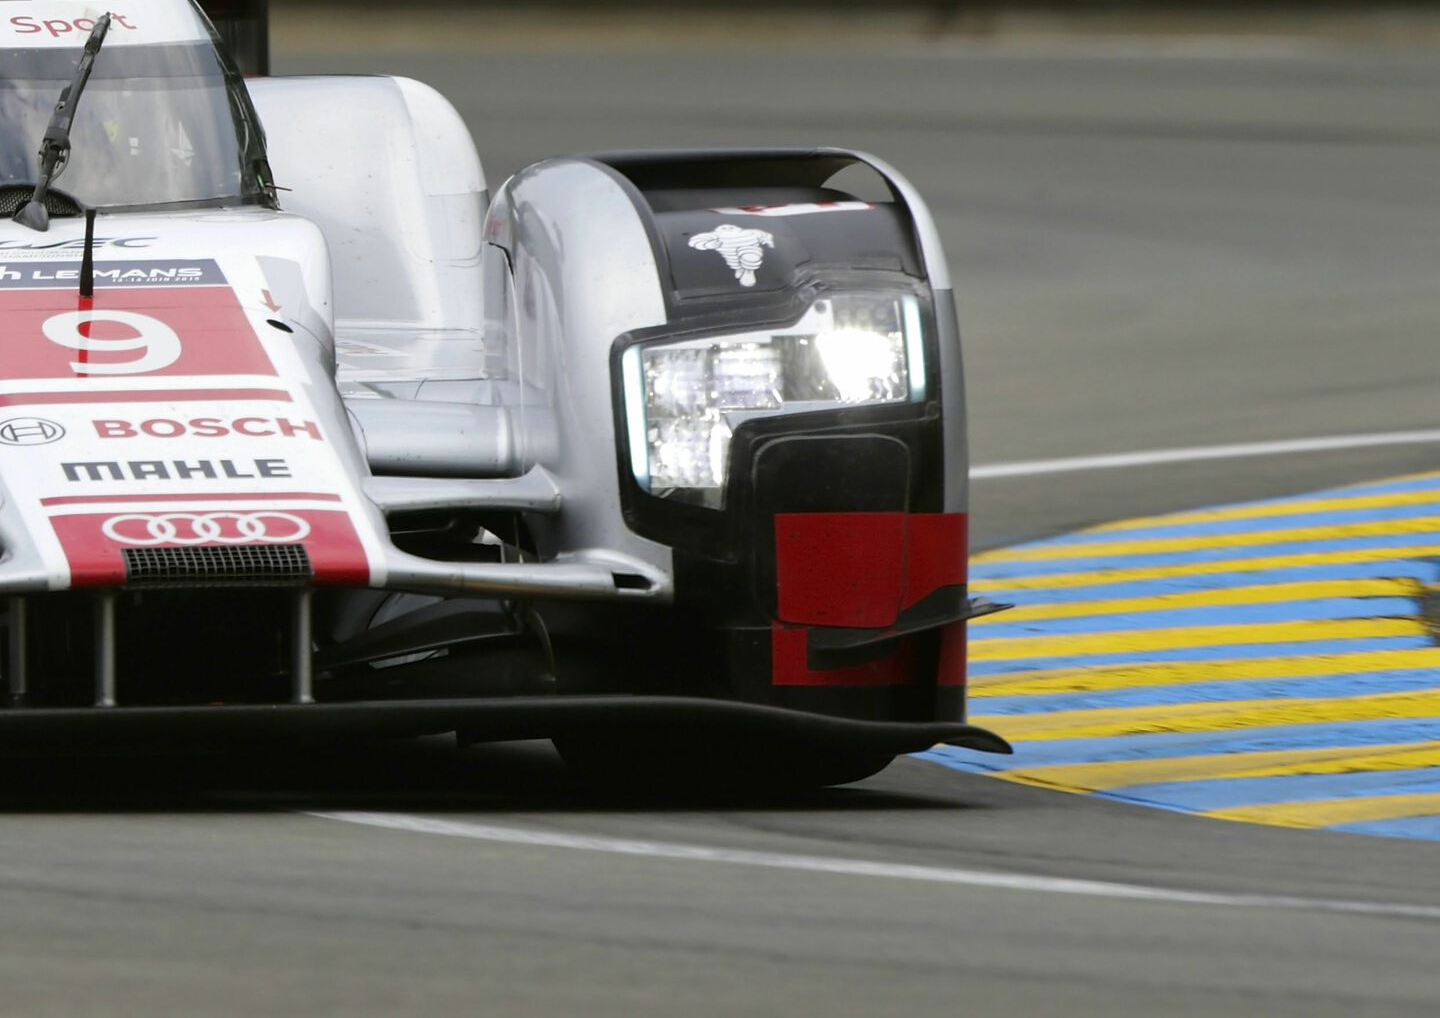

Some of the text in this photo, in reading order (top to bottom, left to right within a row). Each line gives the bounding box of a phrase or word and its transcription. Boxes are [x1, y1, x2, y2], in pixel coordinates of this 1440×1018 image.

[10, 12, 137, 38] Spot
[32, 269, 80, 280] LE
[92, 267, 204, 279] MANS
[41, 309, 182, 375] 9
[92, 417, 323, 441] BOSCH
[60, 458, 293, 482] MAHLE
